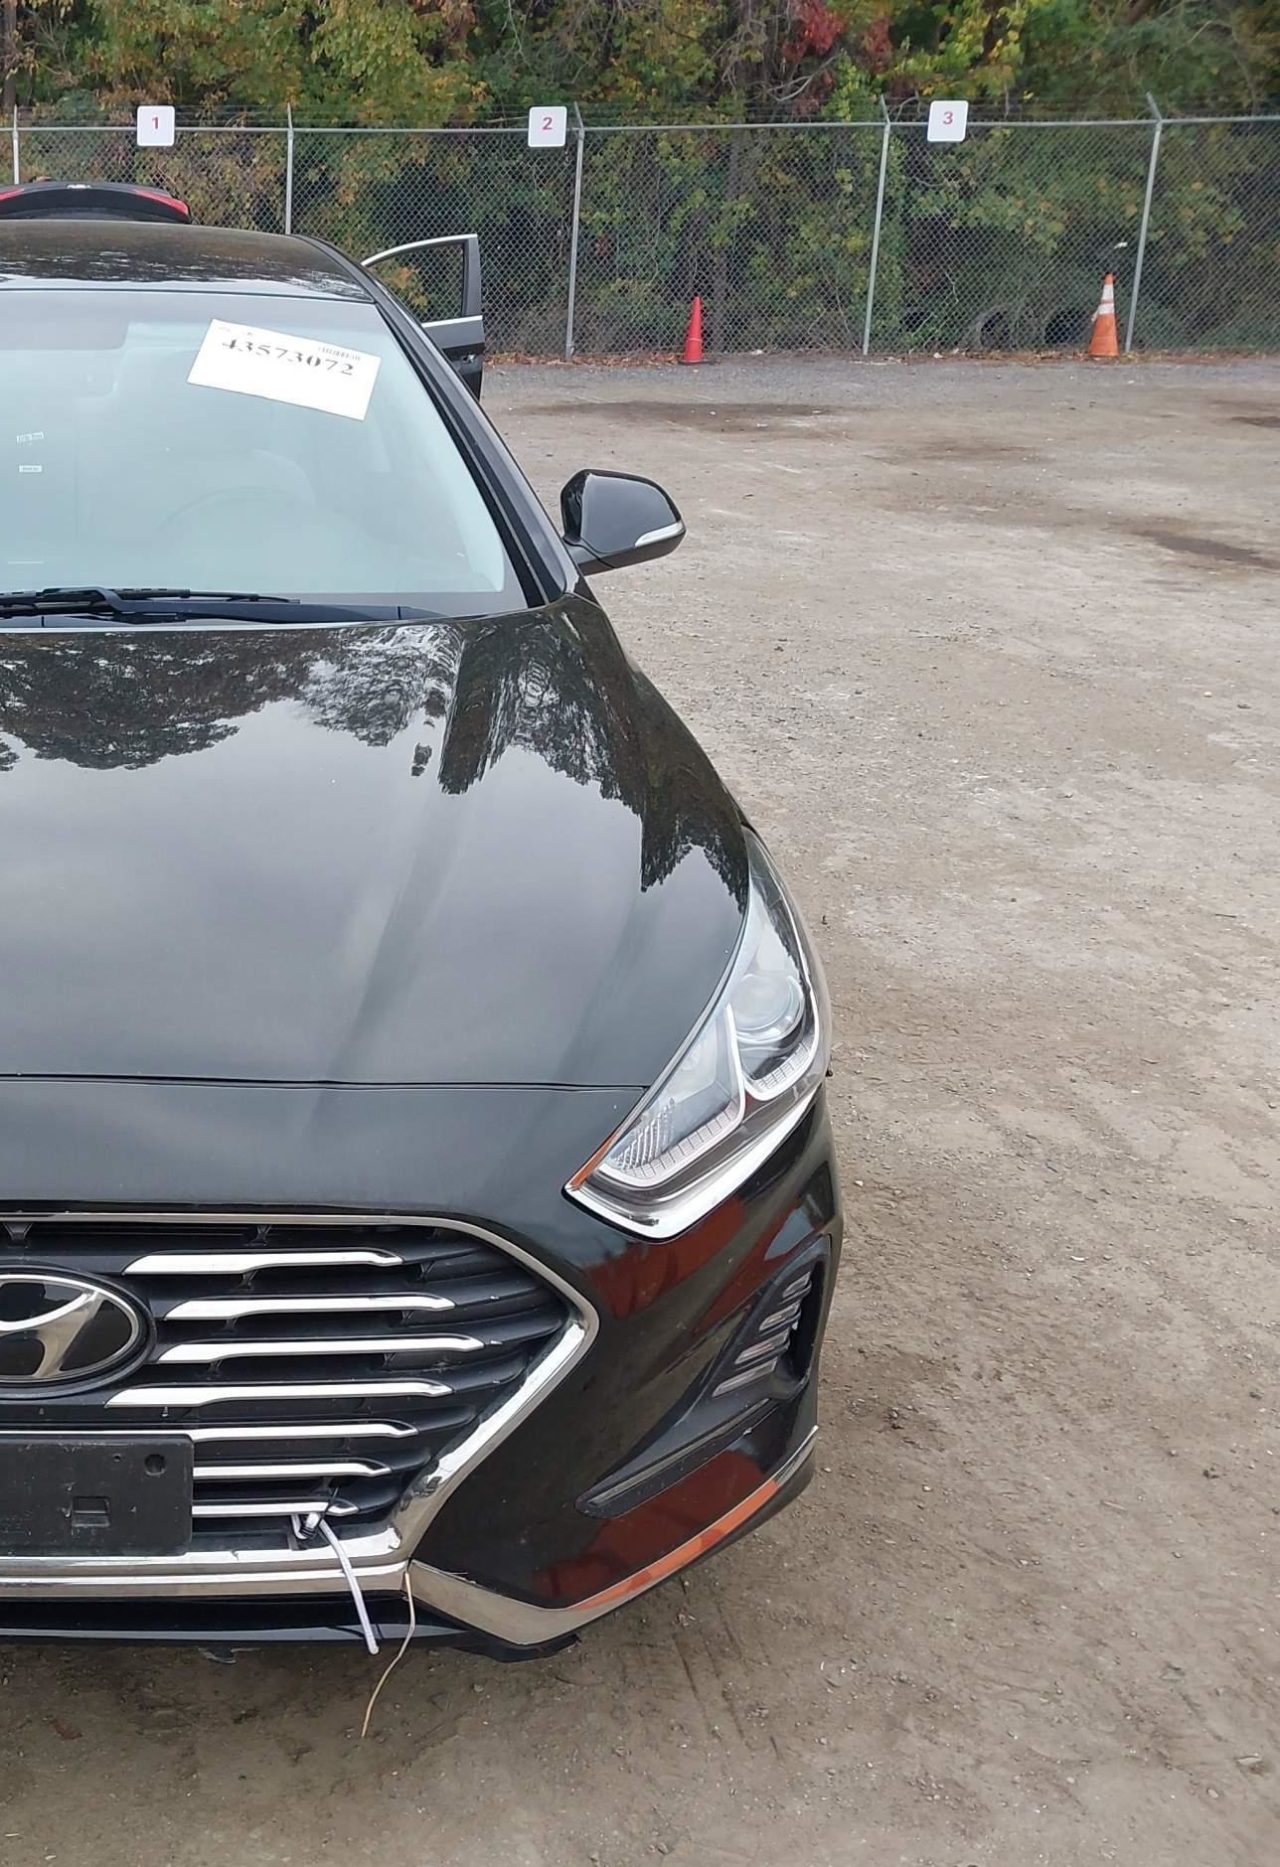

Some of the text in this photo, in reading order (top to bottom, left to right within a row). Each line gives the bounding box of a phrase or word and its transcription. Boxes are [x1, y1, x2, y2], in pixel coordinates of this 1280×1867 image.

[151, 116, 159, 130] 1
[542, 116, 553, 130] 2
[942, 111, 954, 125] 3
[222, 338, 354, 376] 43573072
